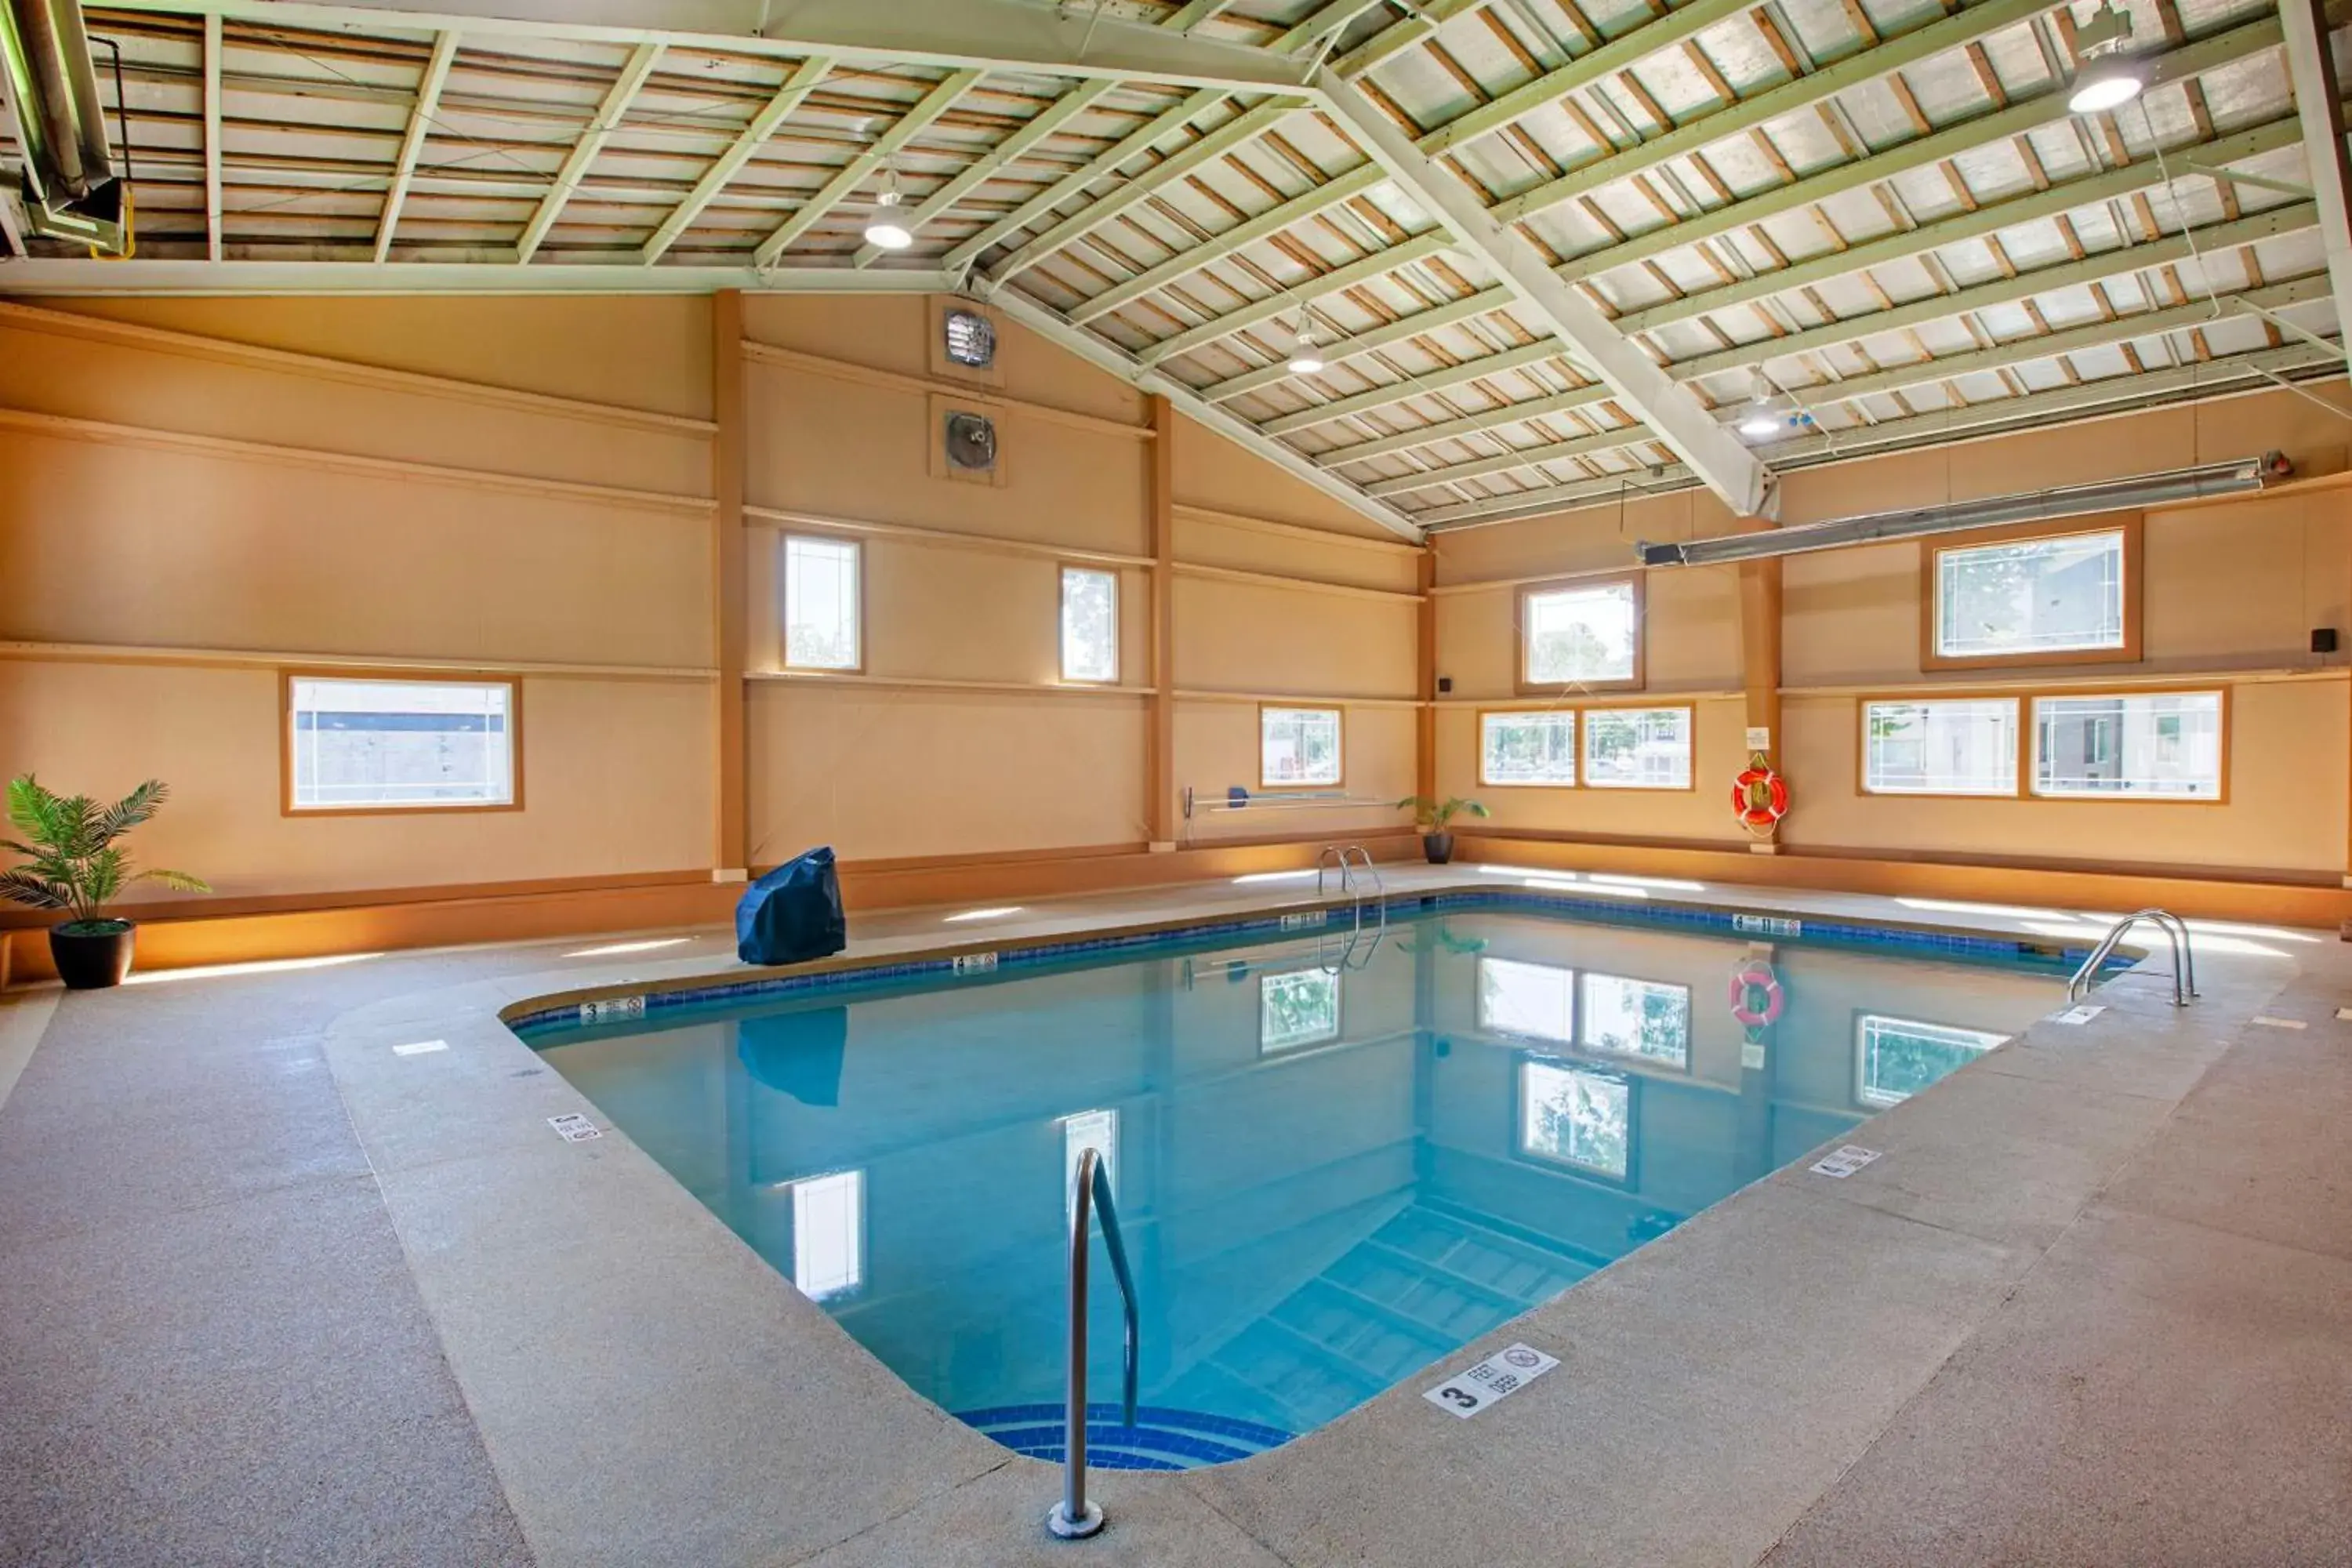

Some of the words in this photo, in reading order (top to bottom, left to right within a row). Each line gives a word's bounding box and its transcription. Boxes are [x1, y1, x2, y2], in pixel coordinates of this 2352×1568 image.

[1467, 1363, 1498, 1382] FEET
[1488, 1374, 1519, 1394] DEEP
[1441, 1387, 1478, 1409] 3
